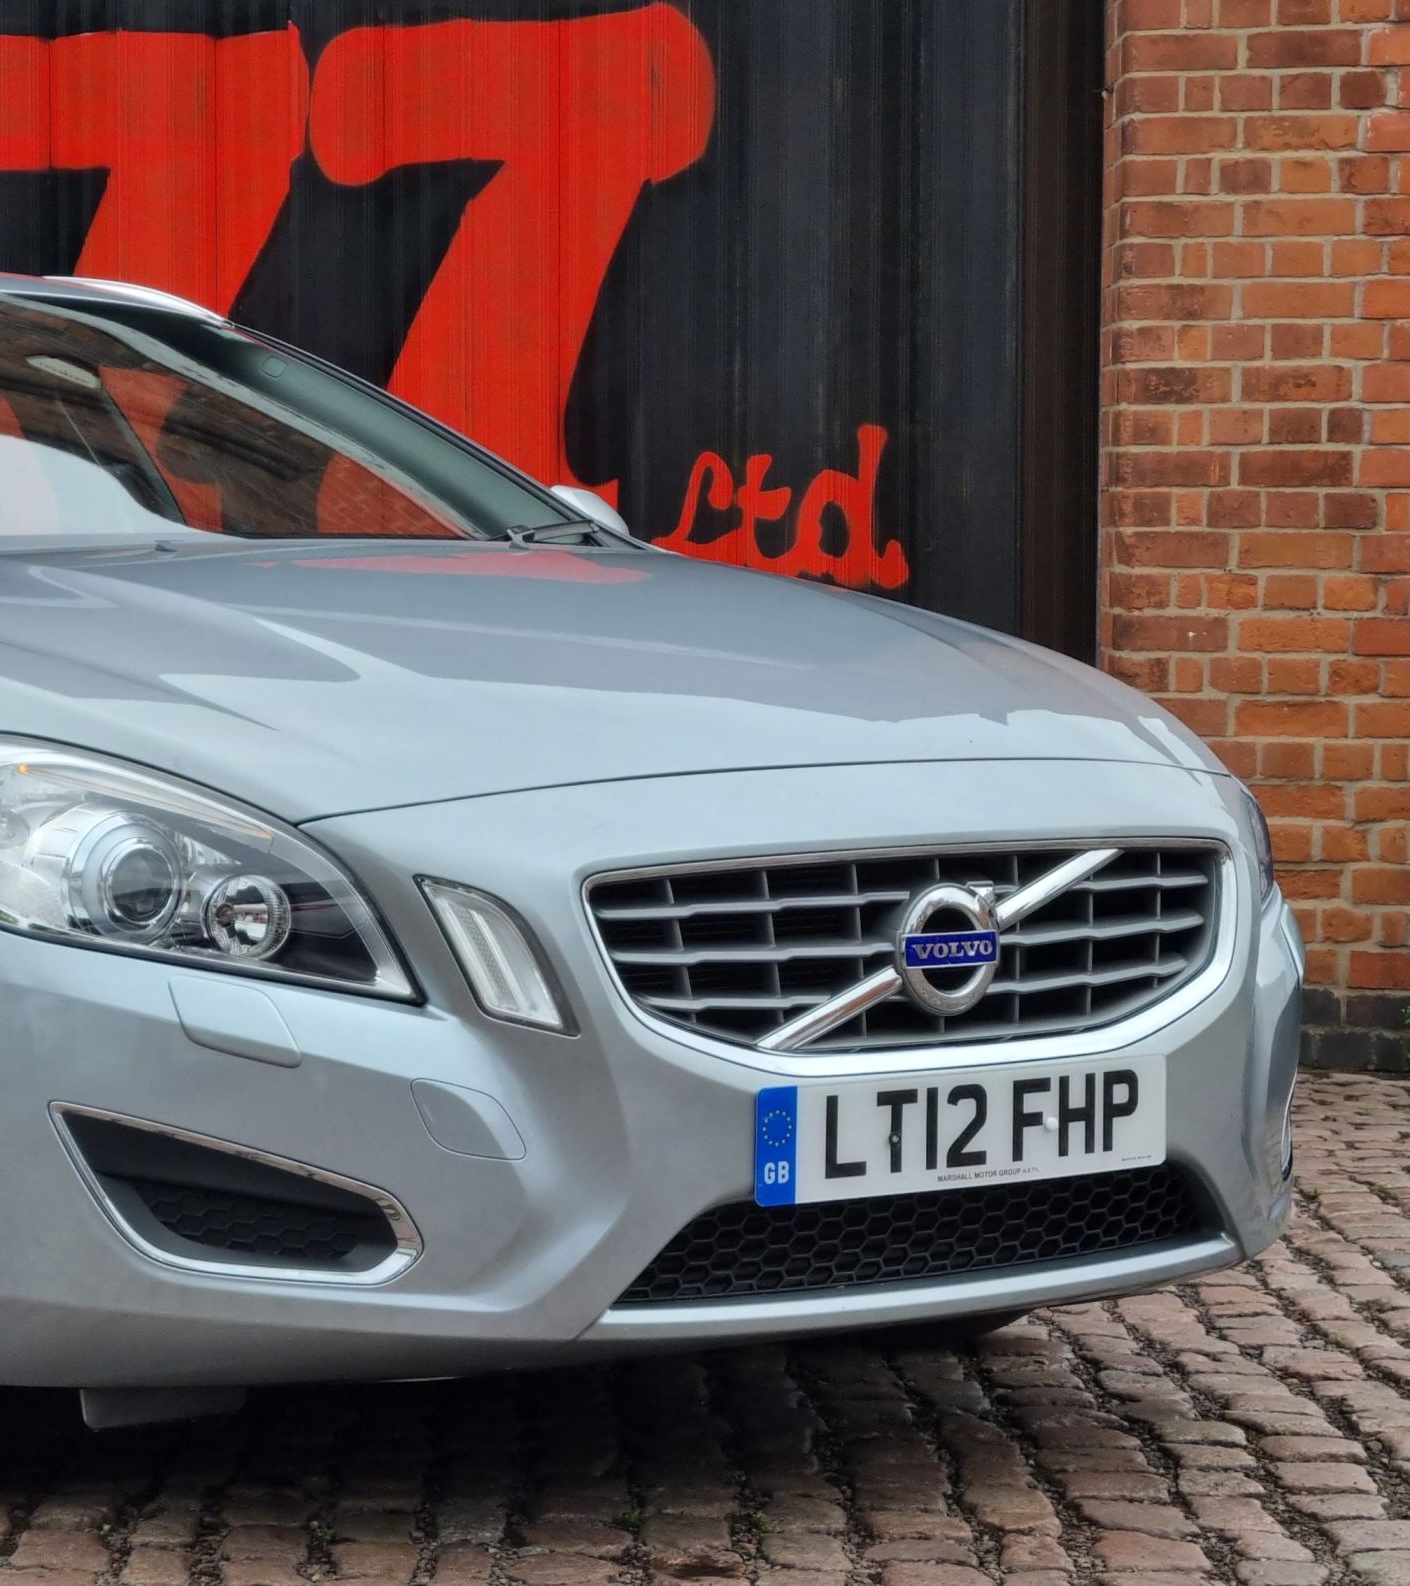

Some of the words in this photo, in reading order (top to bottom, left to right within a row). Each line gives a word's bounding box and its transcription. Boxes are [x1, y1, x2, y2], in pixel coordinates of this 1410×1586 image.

[651, 423, 909, 589] Ltd
[911, 940, 993, 960] VOLVO
[824, 1083, 988, 1179] LT12
[1011, 1068, 1139, 1163] FHP
[763, 1160, 790, 1185] GB
[937, 1172, 973, 1183] MARSHALL
[974, 1169, 998, 1180] MOTOR
[998, 1167, 1021, 1177] GROUP
